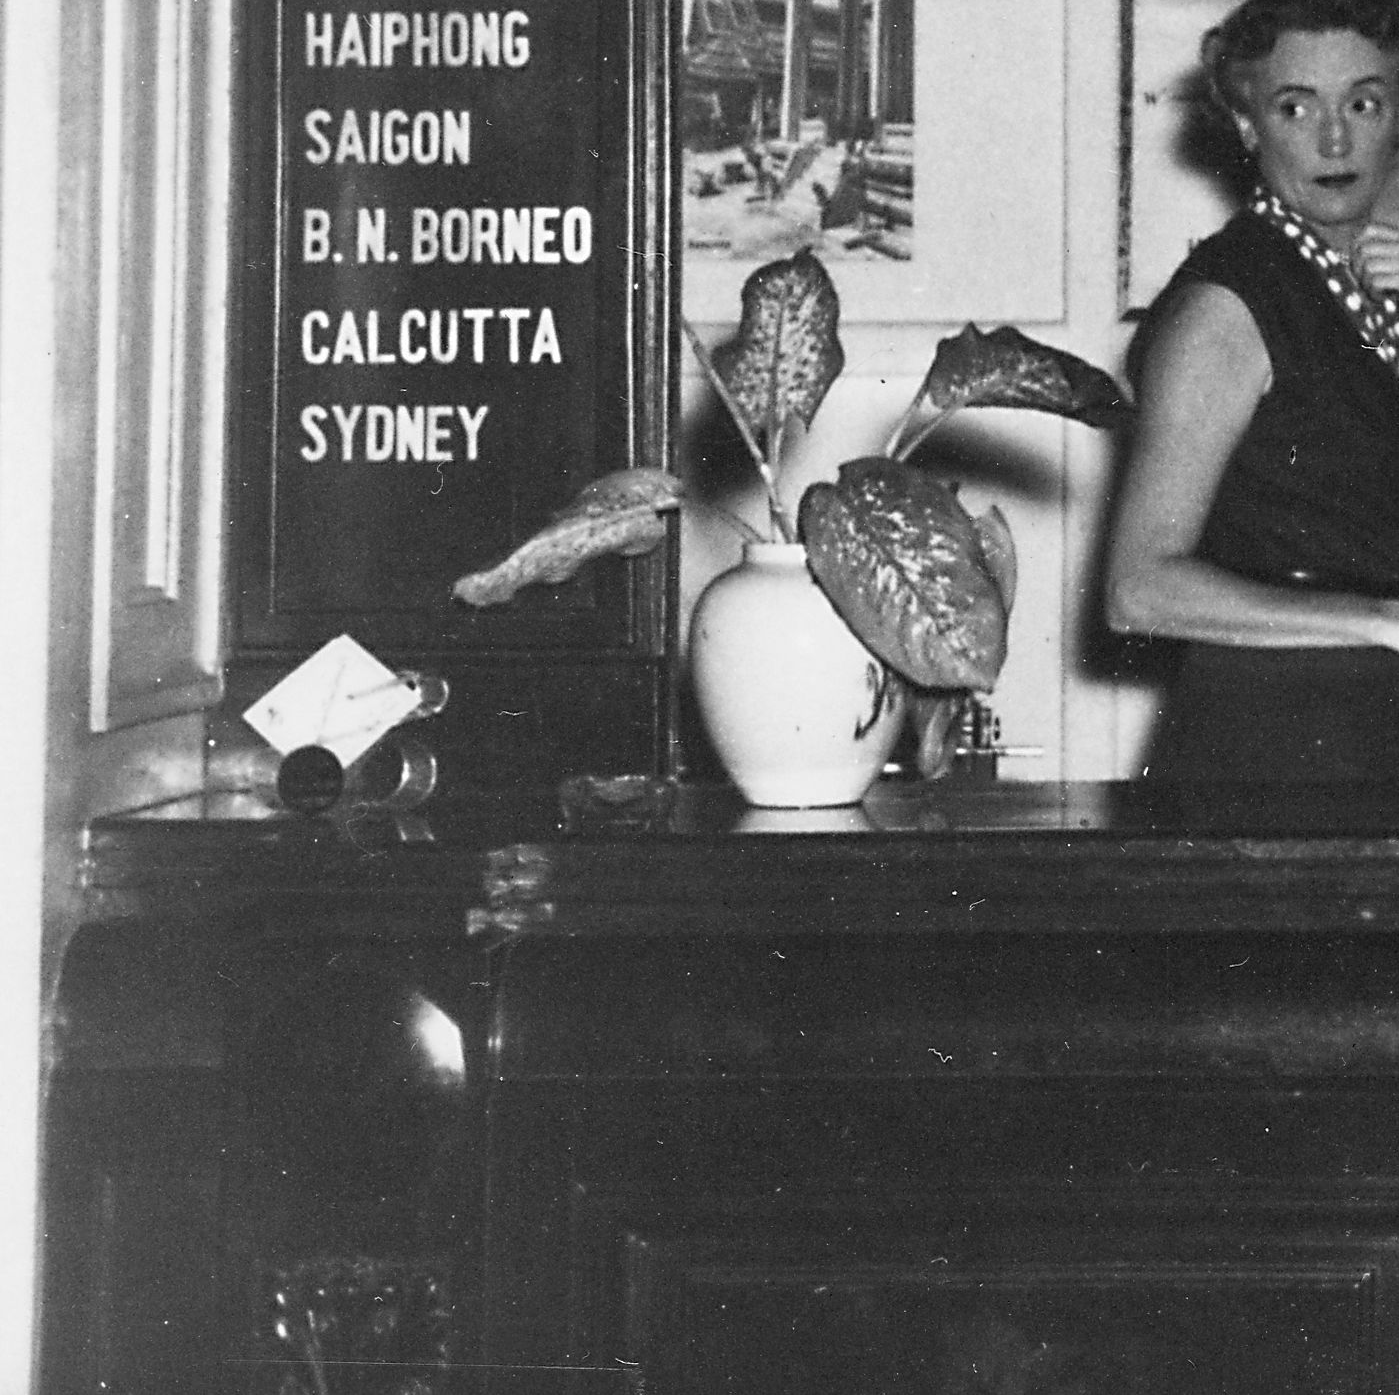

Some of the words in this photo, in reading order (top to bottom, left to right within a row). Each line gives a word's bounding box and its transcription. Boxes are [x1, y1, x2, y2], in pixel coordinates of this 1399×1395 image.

[306, 10, 530, 67] HAIPHONG
[304, 108, 471, 165] SAIGON
[303, 208, 345, 264] B.
[356, 207, 399, 264] N.
[412, 206, 593, 264] BORNEO
[301, 307, 562, 365] CALCUTTA
[300, 404, 489, 462] SYDNEY
